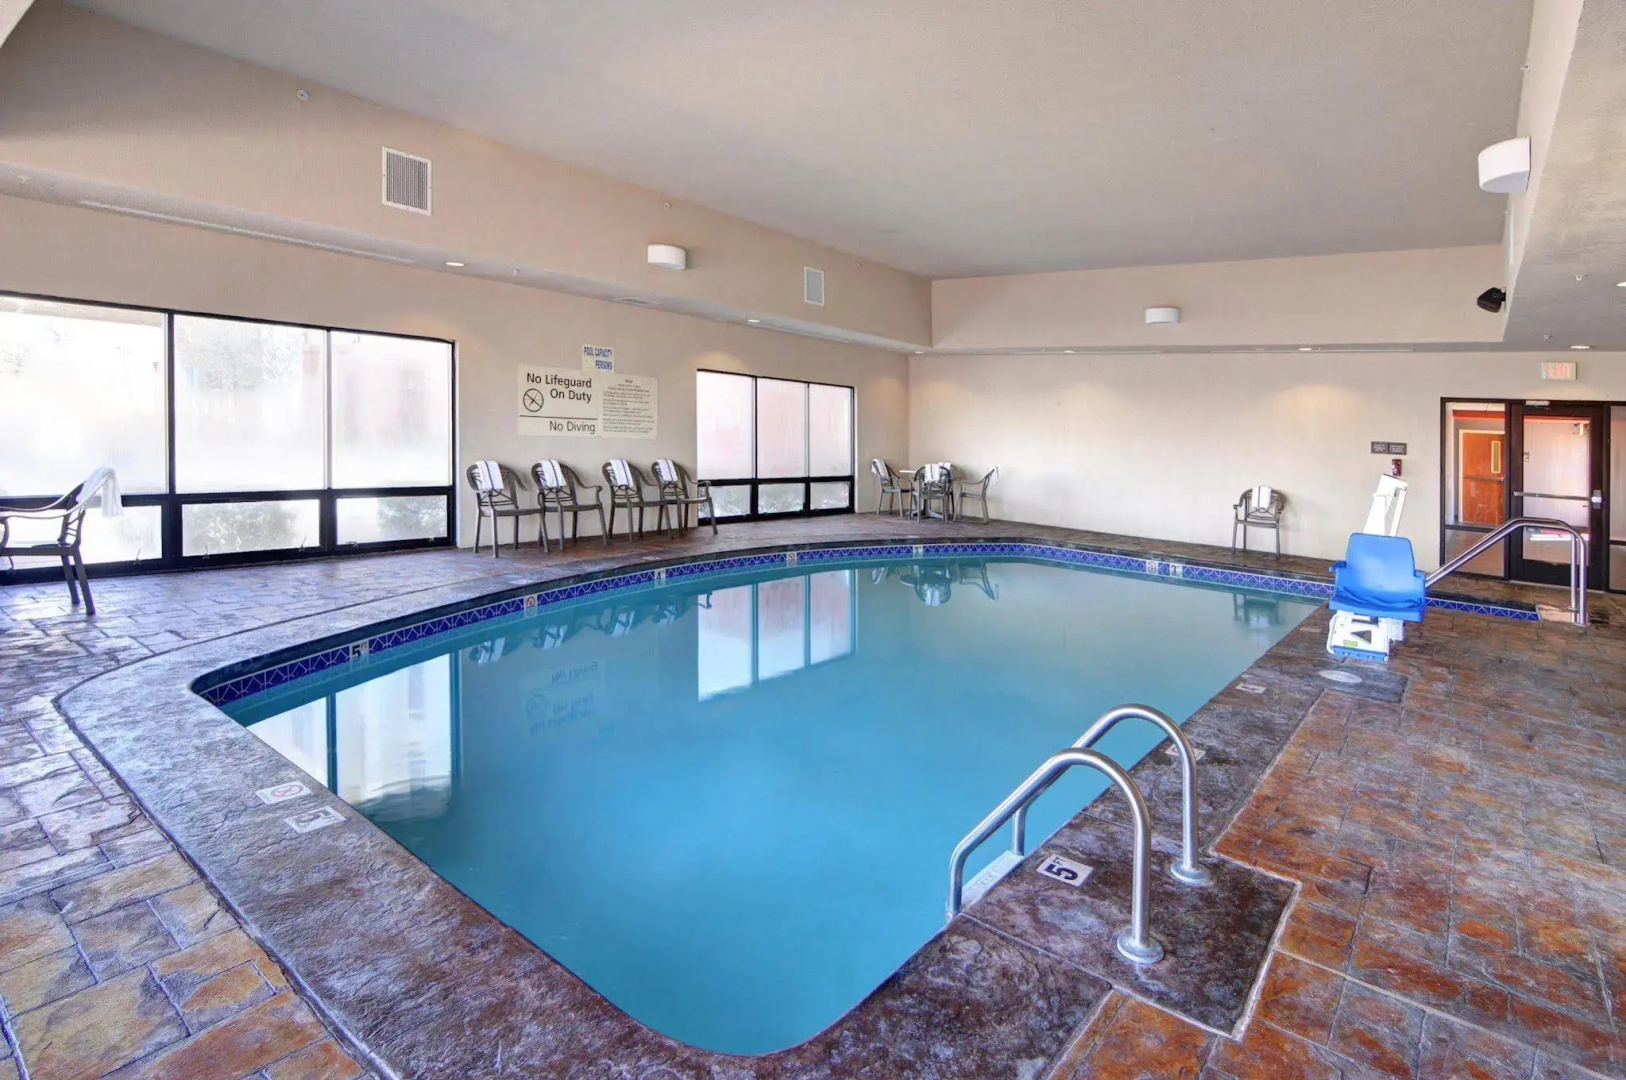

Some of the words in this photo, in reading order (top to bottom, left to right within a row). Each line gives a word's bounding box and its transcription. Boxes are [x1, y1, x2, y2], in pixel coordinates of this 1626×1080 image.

[584, 346, 594, 356] POOL
[595, 347, 612, 357] CAPACITY
[595, 360, 612, 370] PERSONS
[526, 372, 542, 384] No
[545, 373, 592, 389] Lifeguard
[550, 388, 565, 400] On
[568, 389, 592, 404] Duty
[549, 420, 564, 432] No
[566, 421, 596, 435] Diving
[1171, 565, 1177, 576] 3
[352, 644, 361, 658] 5
[1045, 864, 1078, 880] 5
